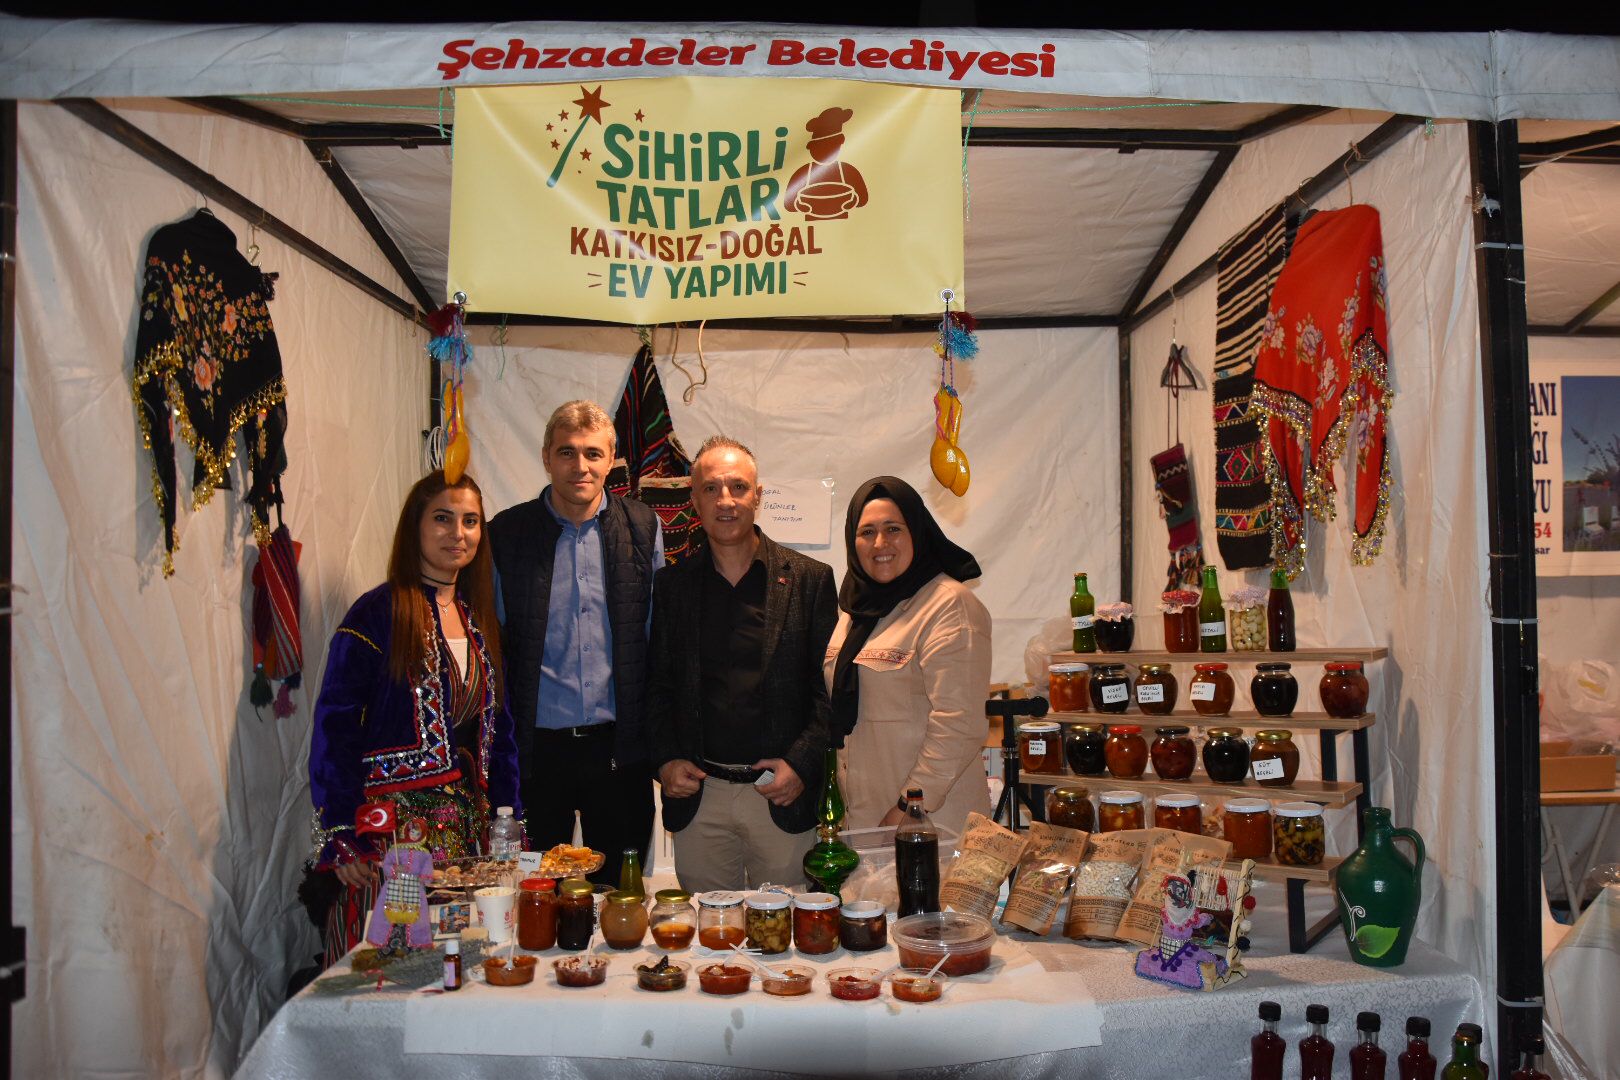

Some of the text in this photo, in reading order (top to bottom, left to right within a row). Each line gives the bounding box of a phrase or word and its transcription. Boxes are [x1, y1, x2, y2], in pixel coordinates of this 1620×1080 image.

[437, 38, 1056, 81] Şehzadeler Belediyesi
[596, 177, 781, 230] TATLAR
[570, 223, 822, 262] KATKISIZ-DOĞAL
[608, 261, 787, 299] EV YAPIMI
[1529, 382, 1557, 416] ANI
[1531, 422, 1549, 465] ĞI
[1533, 522, 1553, 539] 54
